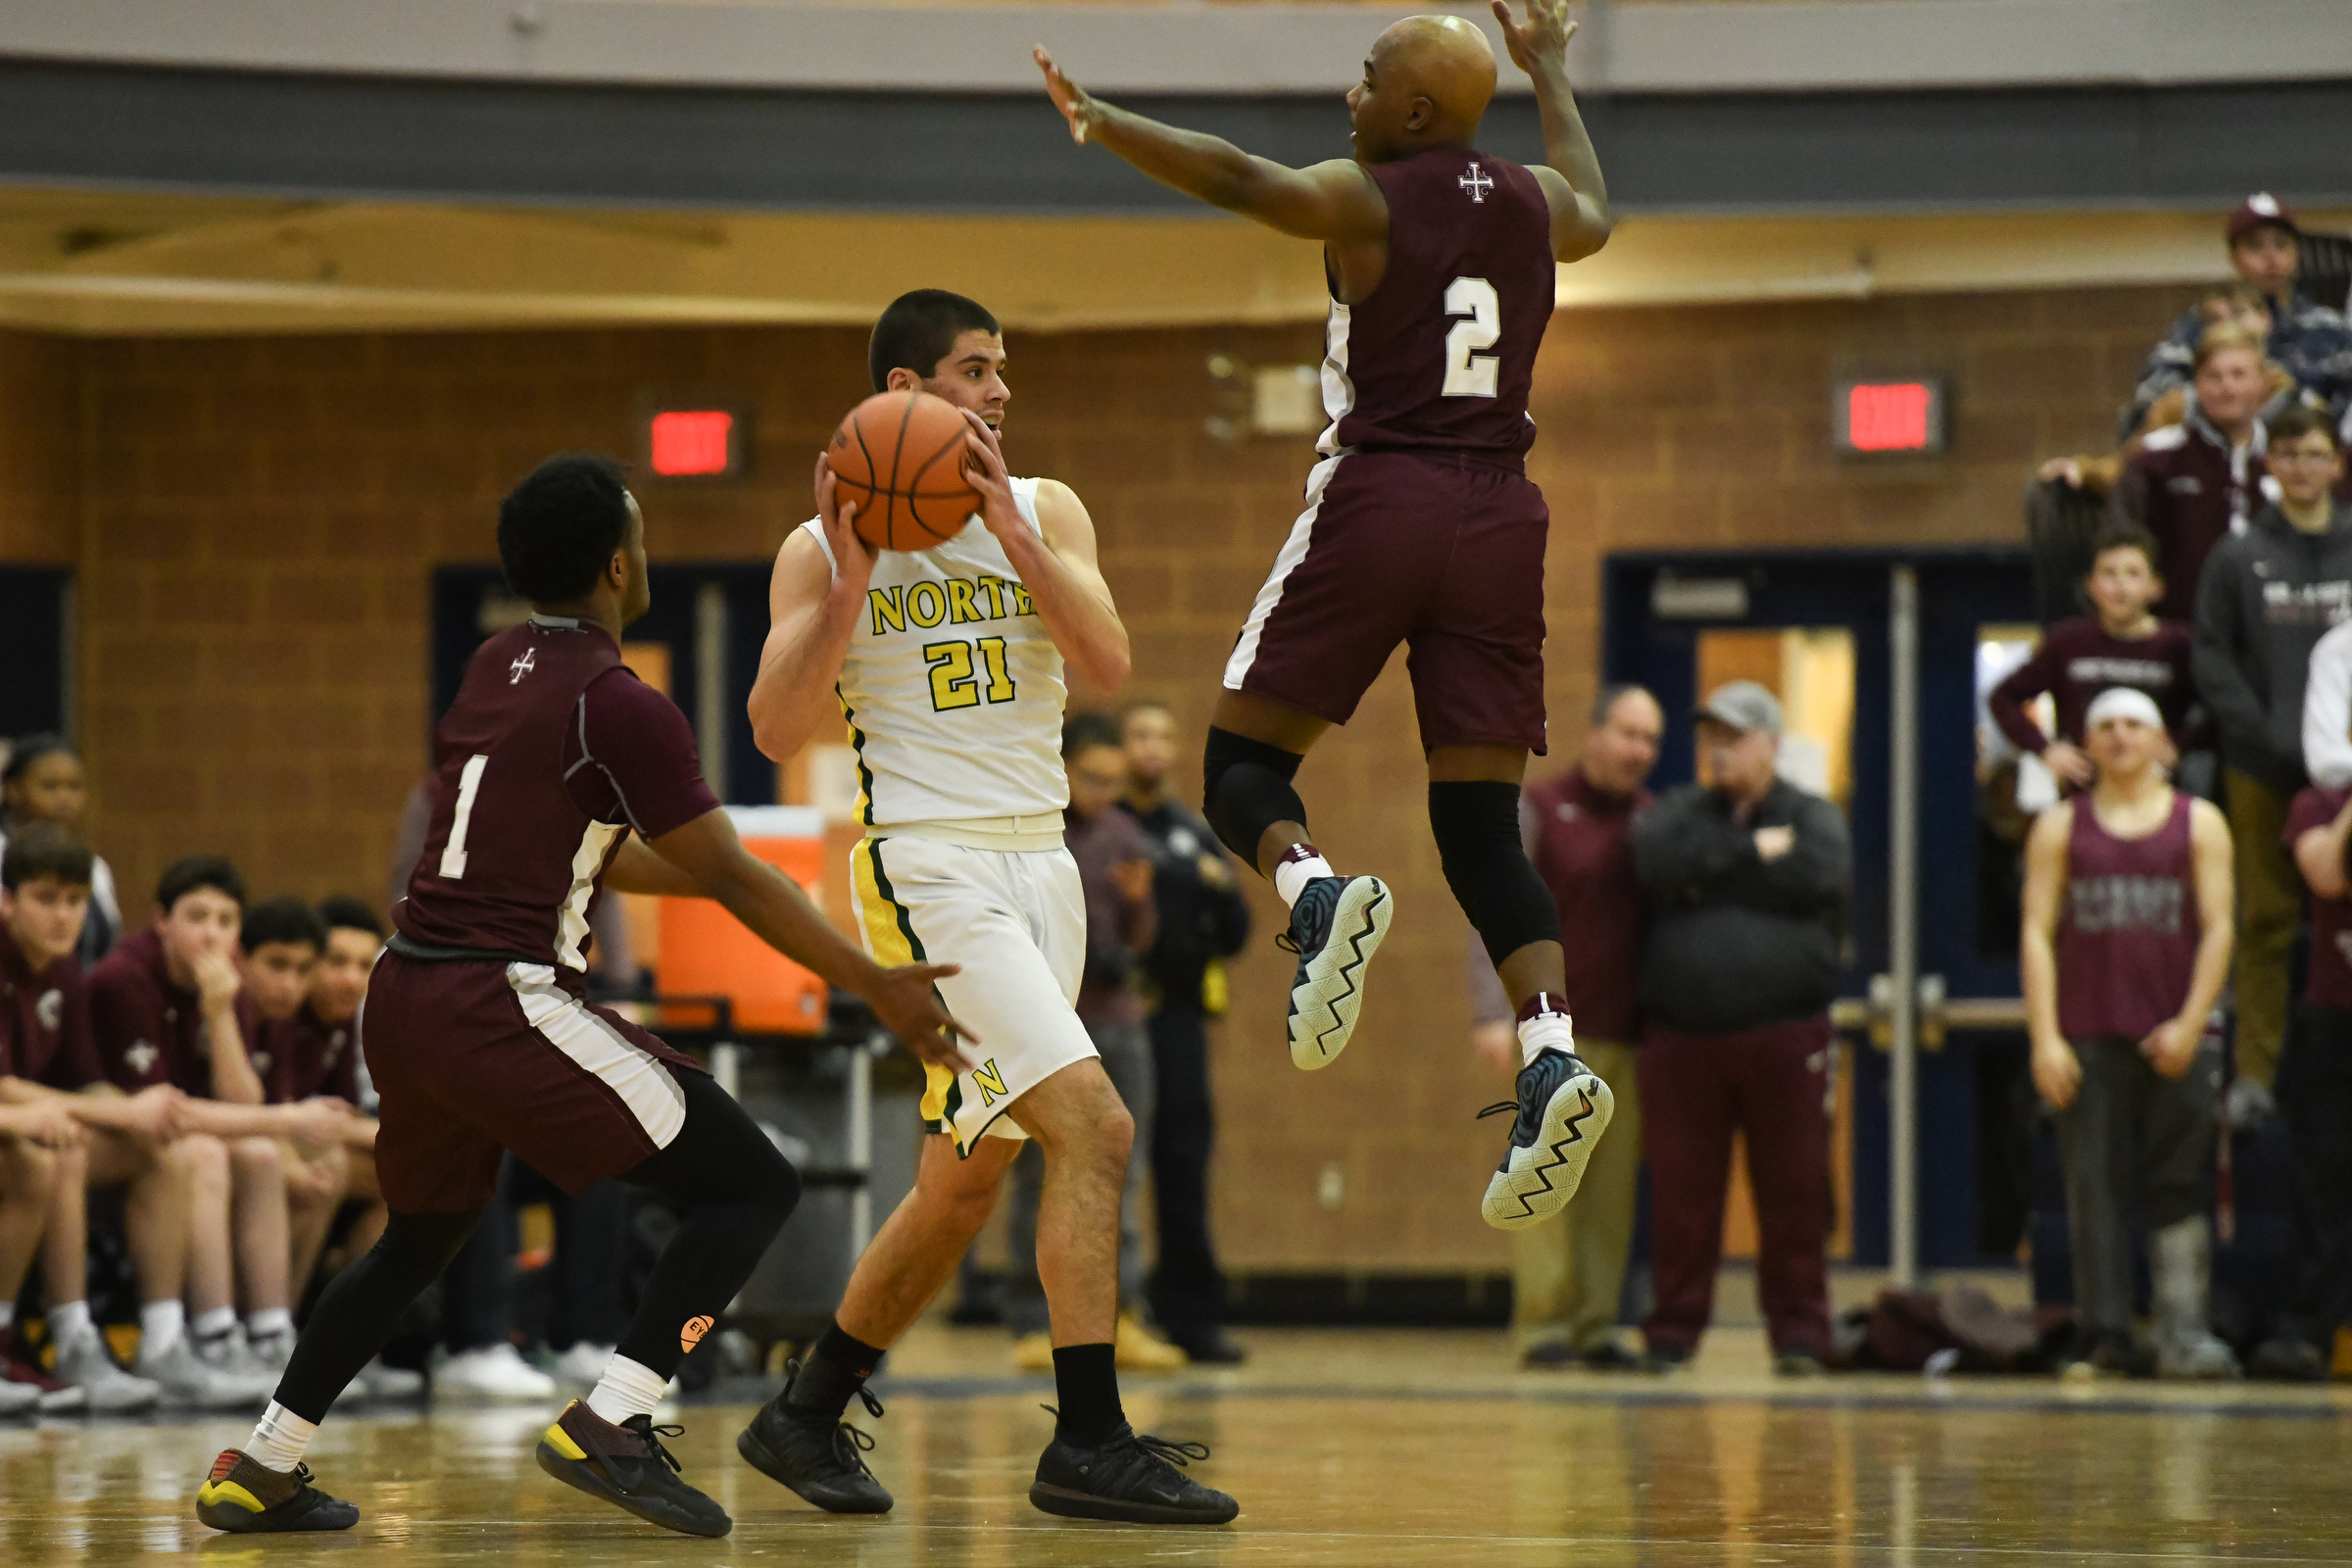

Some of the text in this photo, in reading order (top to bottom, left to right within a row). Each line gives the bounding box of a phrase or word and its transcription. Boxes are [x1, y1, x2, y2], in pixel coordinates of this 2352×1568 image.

[1442, 276, 1500, 398] 2
[923, 636, 1016, 712] 21
[438, 754, 489, 879] 1
[971, 1057, 1008, 1107] N
